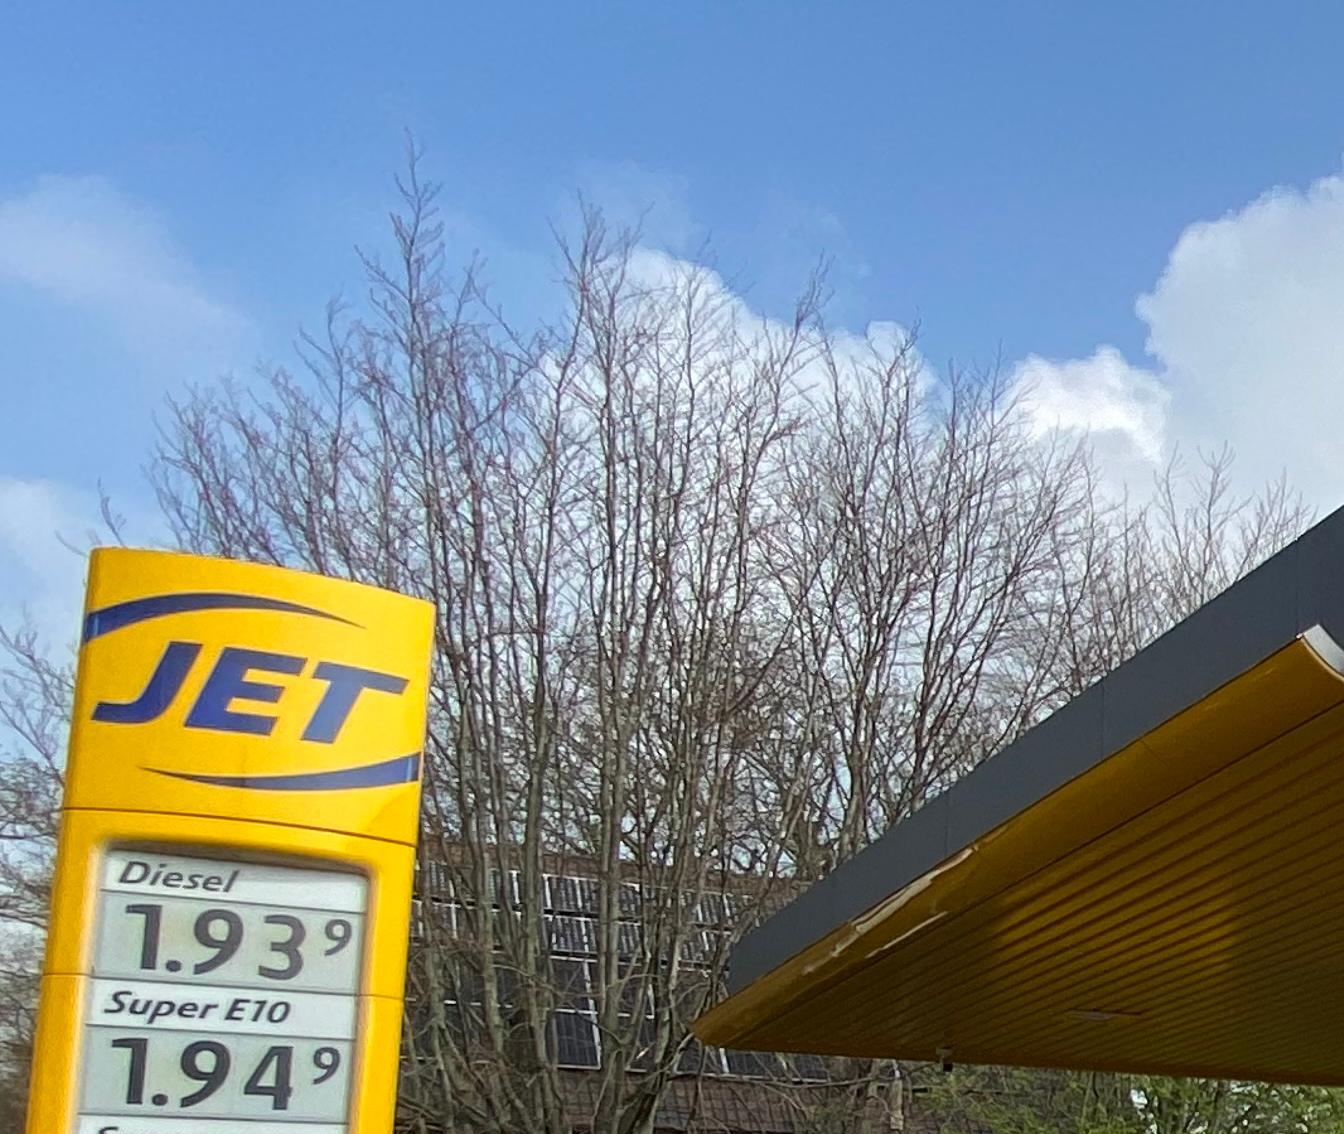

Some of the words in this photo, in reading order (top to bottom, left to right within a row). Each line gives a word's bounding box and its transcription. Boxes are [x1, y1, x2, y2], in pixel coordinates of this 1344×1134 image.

[91, 641, 410, 745] JET
[118, 861, 239, 894] Diesel
[104, 991, 219, 1024] Super
[224, 998, 291, 1024] E10
